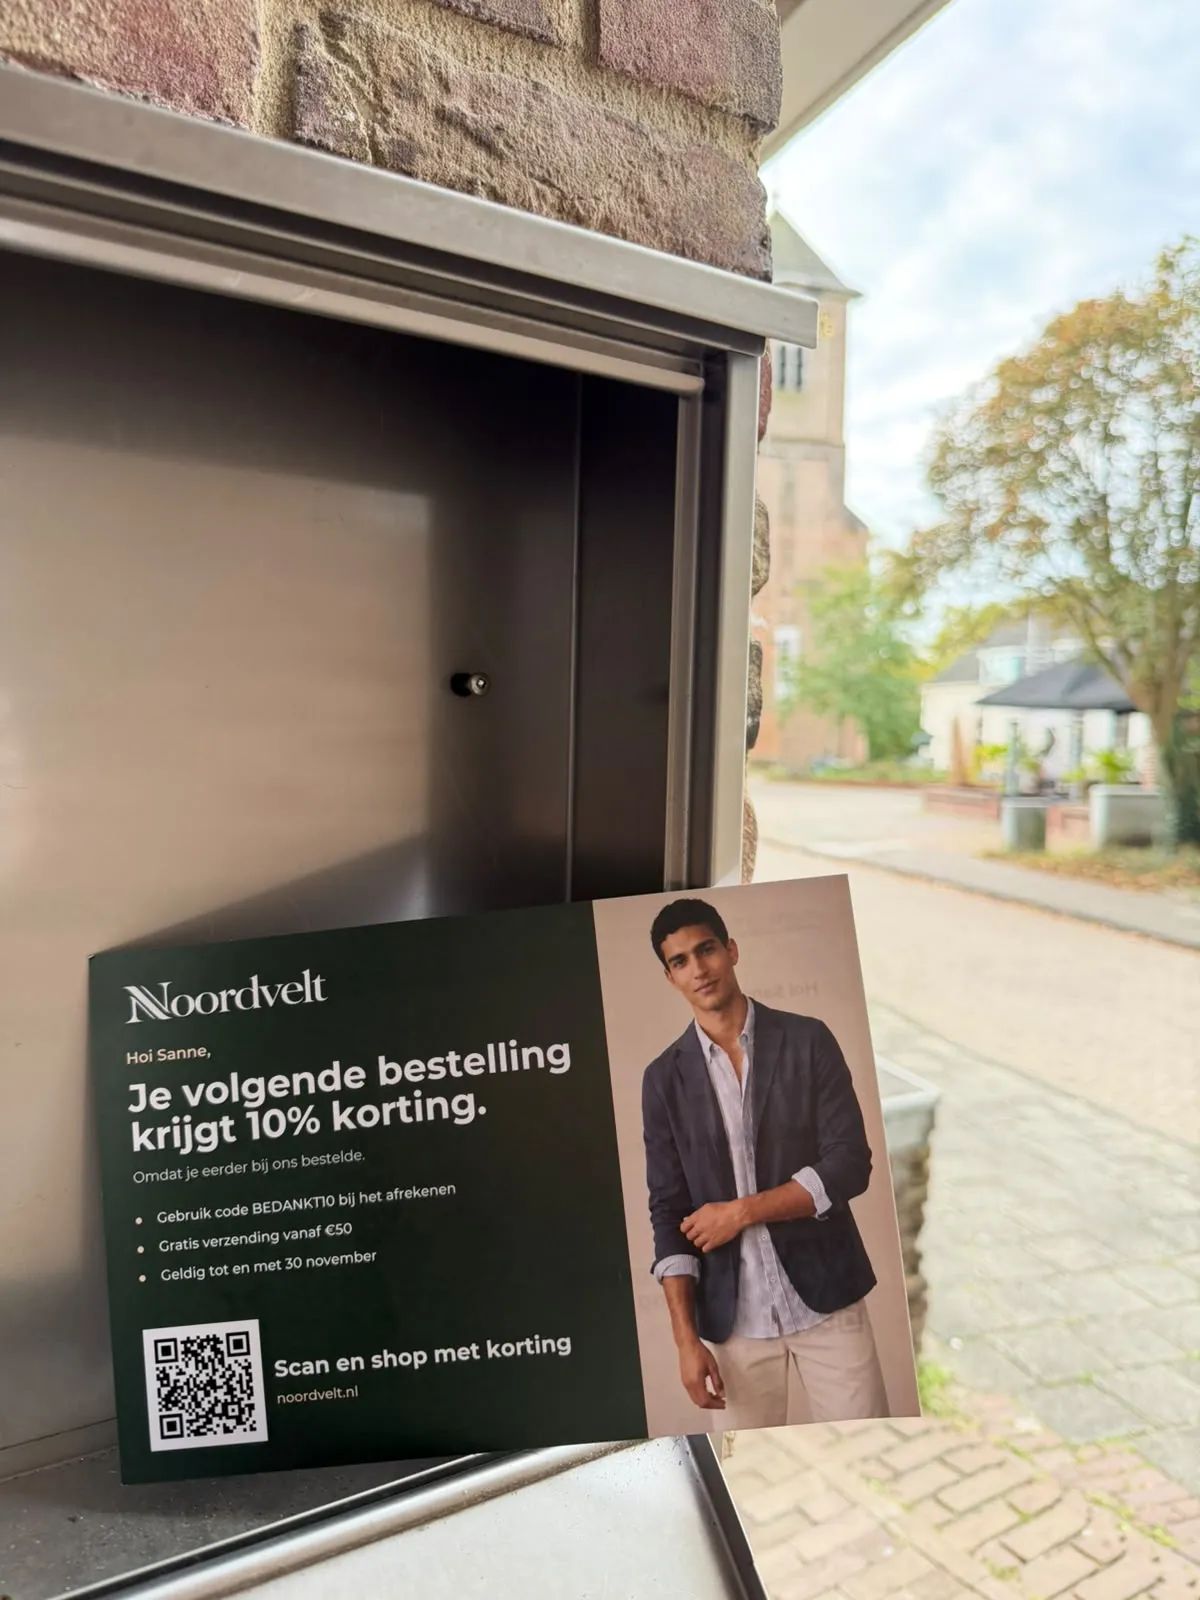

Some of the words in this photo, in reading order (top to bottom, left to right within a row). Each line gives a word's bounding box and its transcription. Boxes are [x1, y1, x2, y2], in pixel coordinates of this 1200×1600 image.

[122, 968, 329, 1024] Noordvelt
[126, 1048, 153, 1065] Hoi
[156, 1046, 212, 1062] Sanne,
[127, 1083, 173, 1113] Je
[181, 1060, 367, 1108] volgende
[377, 1039, 571, 1087] bestelling
[131, 1114, 237, 1155] krijgt
[245, 1104, 321, 1140] 10%
[332, 1089, 487, 1132] korting.
[132, 1168, 183, 1184] Omdat
[184, 1165, 199, 1182] je
[201, 1161, 249, 1177] eerder
[251, 1157, 269, 1175] bij
[271, 1158, 298, 1170] ons
[301, 1149, 366, 1167] bestelde.
[156, 1206, 212, 1224] Gebruik
[214, 1203, 249, 1219] code
[251, 1194, 336, 1215] BEDANKT10
[338, 1191, 356, 1208] bij
[358, 1191, 383, 1204] het
[385, 1184, 456, 1201] afrekenen
[158, 1237, 200, 1253] Gratis
[201, 1230, 280, 1248] verzending
[282, 1224, 322, 1241] vanaf
[324, 1222, 353, 1237] €50
[160, 1265, 206, 1281] Geldig
[208, 1264, 230, 1277] tot
[232, 1263, 250, 1275] en
[253, 1259, 283, 1273] met
[284, 1256, 303, 1270] 30
[305, 1250, 377, 1268] november
[274, 1359, 330, 1378] Scan
[335, 1356, 365, 1372] en
[370, 1348, 428, 1370] shop
[434, 1342, 481, 1364] met
[486, 1334, 572, 1359] korting
[276, 1384, 359, 1405] noordvelt.nl
